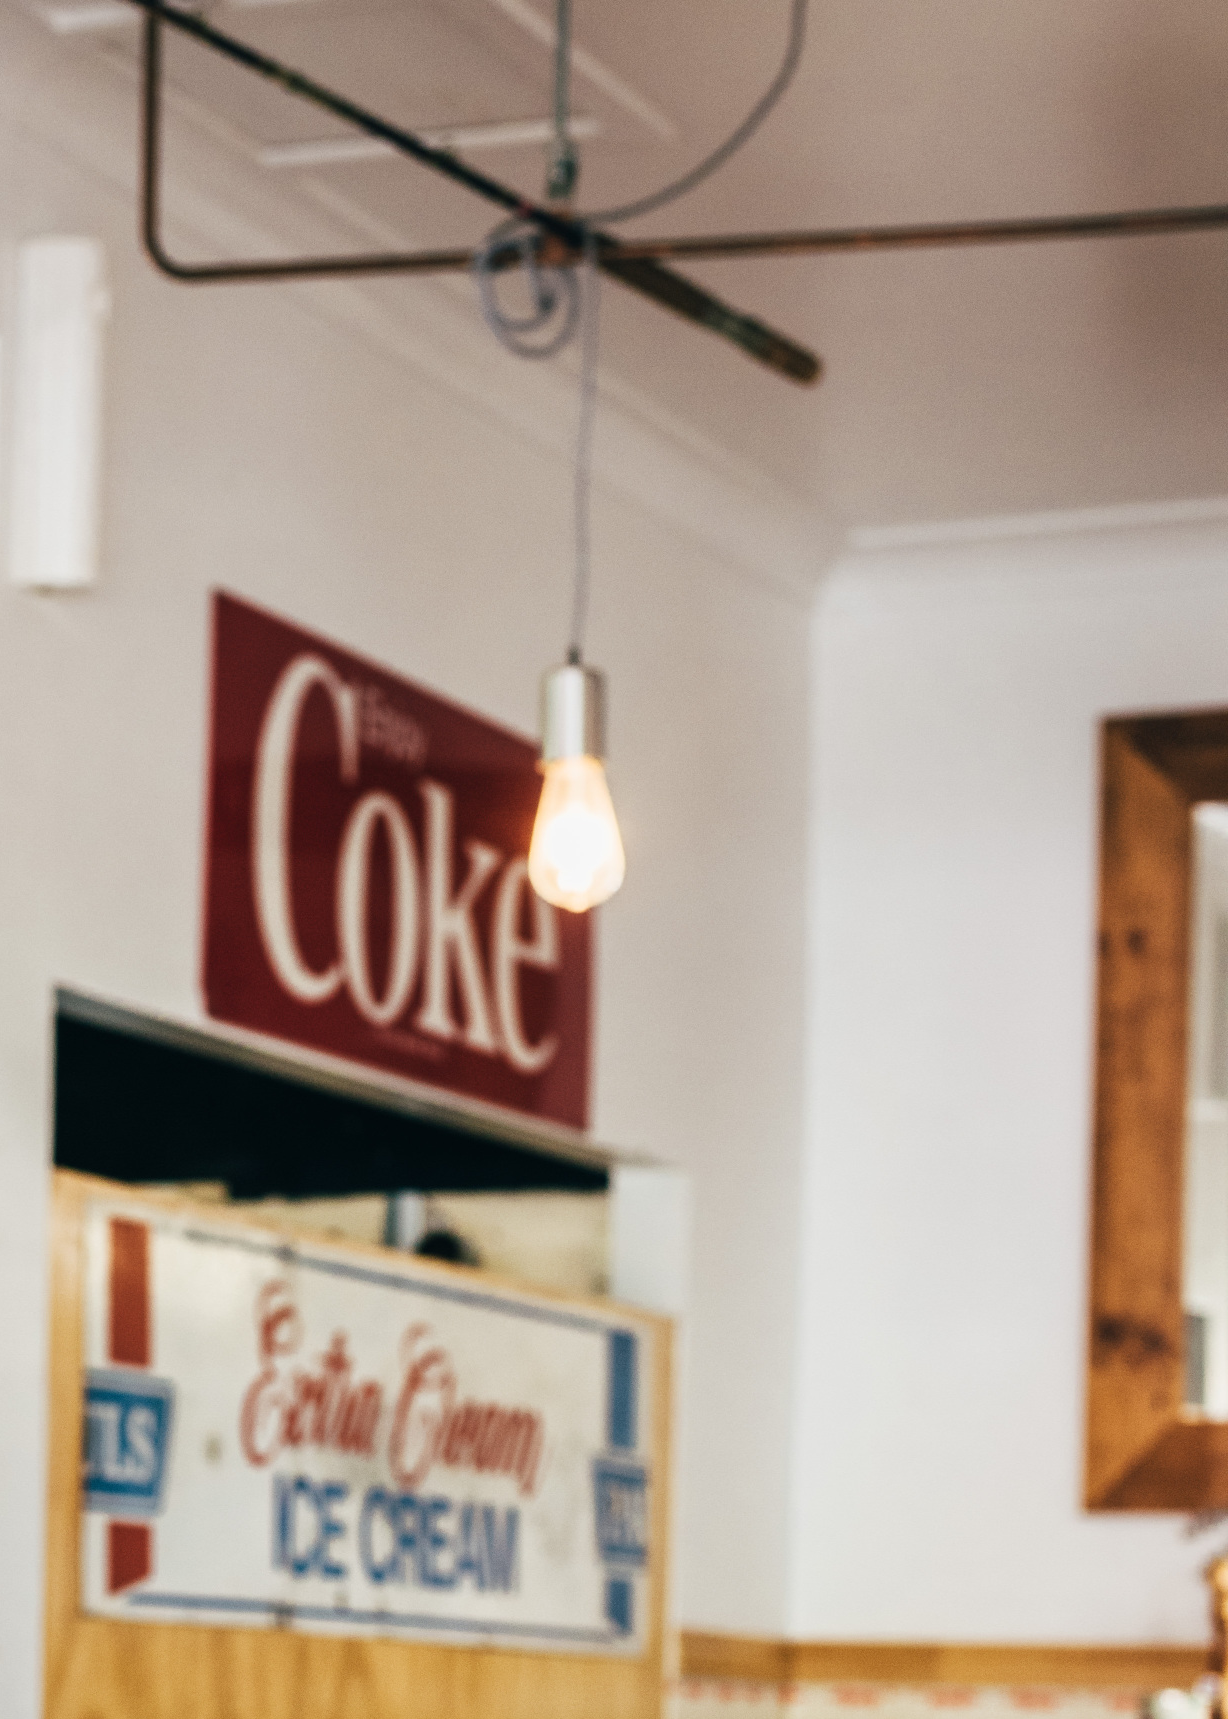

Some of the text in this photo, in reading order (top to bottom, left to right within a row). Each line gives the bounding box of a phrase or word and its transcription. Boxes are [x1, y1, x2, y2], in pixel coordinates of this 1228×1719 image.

[252, 651, 562, 1075] Coke
[273, 1472, 350, 1580] ICE
[359, 1486, 520, 1594] CREAM
